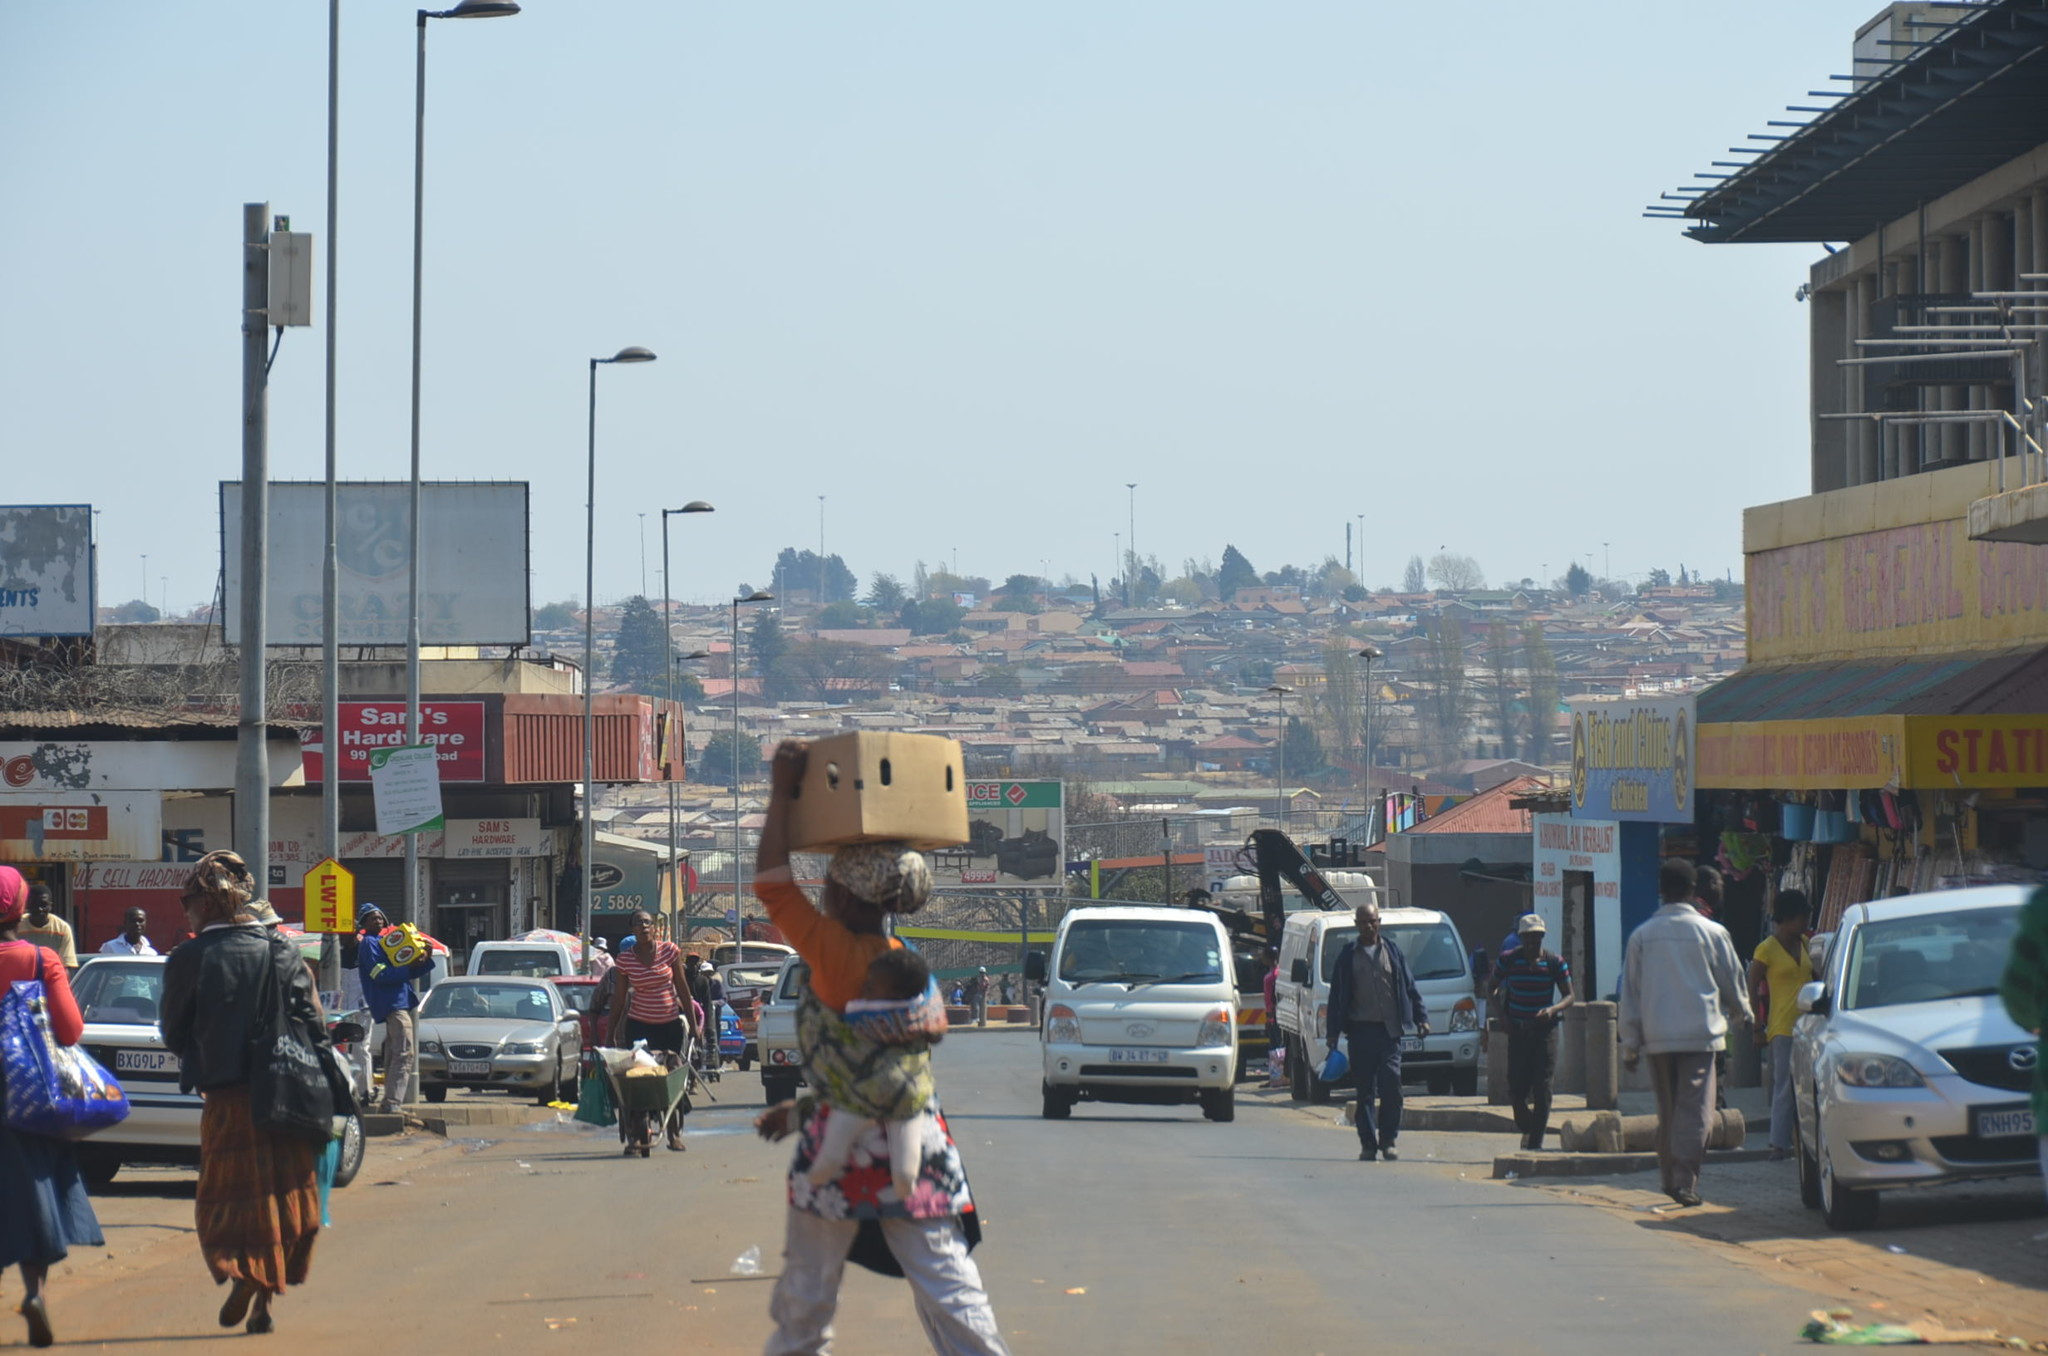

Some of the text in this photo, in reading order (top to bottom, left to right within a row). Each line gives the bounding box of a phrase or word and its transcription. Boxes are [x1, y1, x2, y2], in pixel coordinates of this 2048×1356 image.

[294, 622, 463, 637] COSMETCS
[1588, 709, 1611, 770] Fish
[1614, 708, 1635, 770] and
[1637, 707, 1671, 777] Chips
[350, 751, 367, 760] 99
[478, 820, 510, 833] SAM'S
[471, 834, 516, 845] HARDWARE
[101, 868, 131, 888] SELL
[607, 895, 643, 910] 5862
[1981, 1112, 2033, 1134] RNH95
